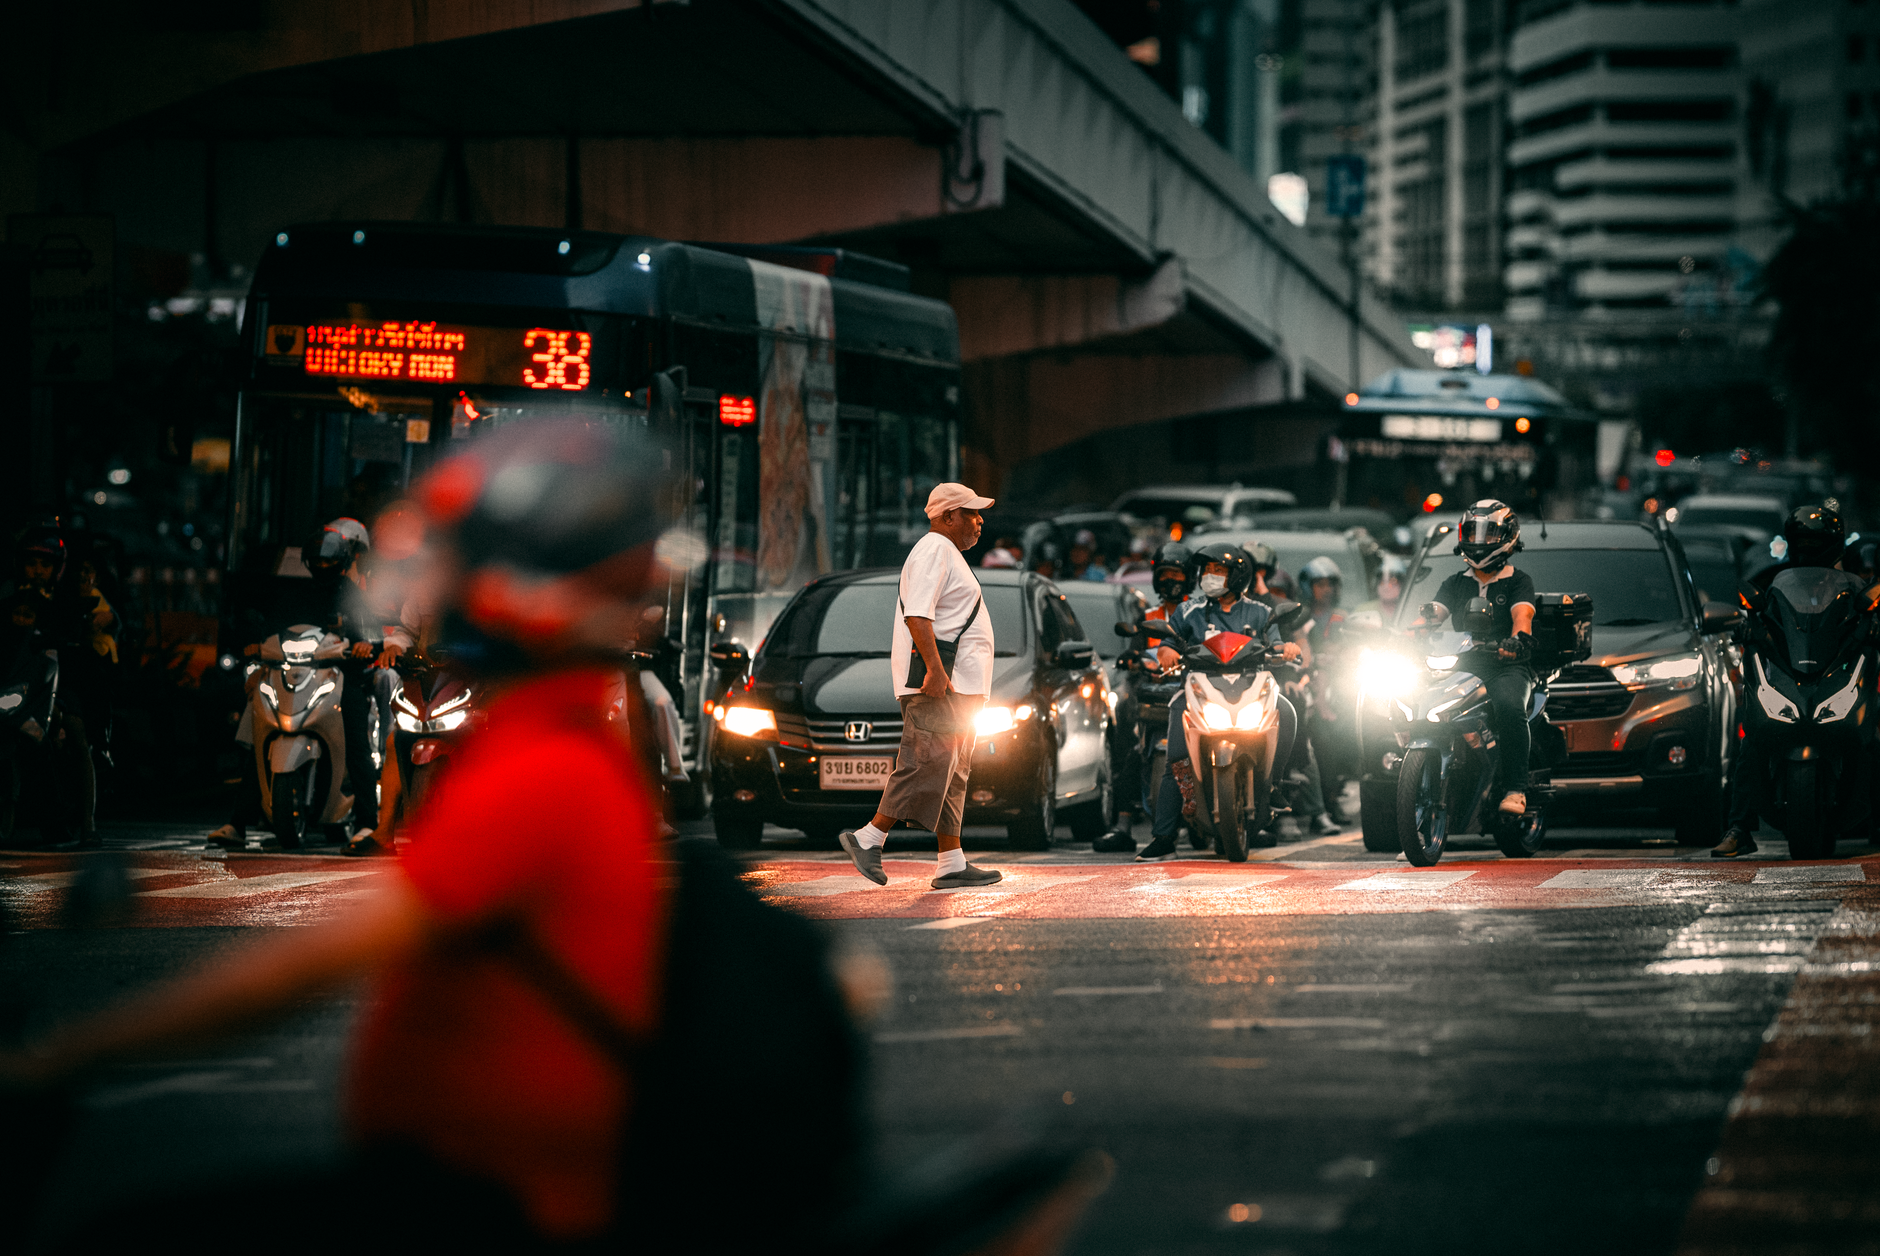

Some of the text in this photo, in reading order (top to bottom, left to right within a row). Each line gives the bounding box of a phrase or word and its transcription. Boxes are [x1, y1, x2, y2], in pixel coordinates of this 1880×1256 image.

[306, 347, 404, 376] VICTORY
[523, 328, 591, 390] 38
[825, 761, 888, 774] 3ขย 6802
